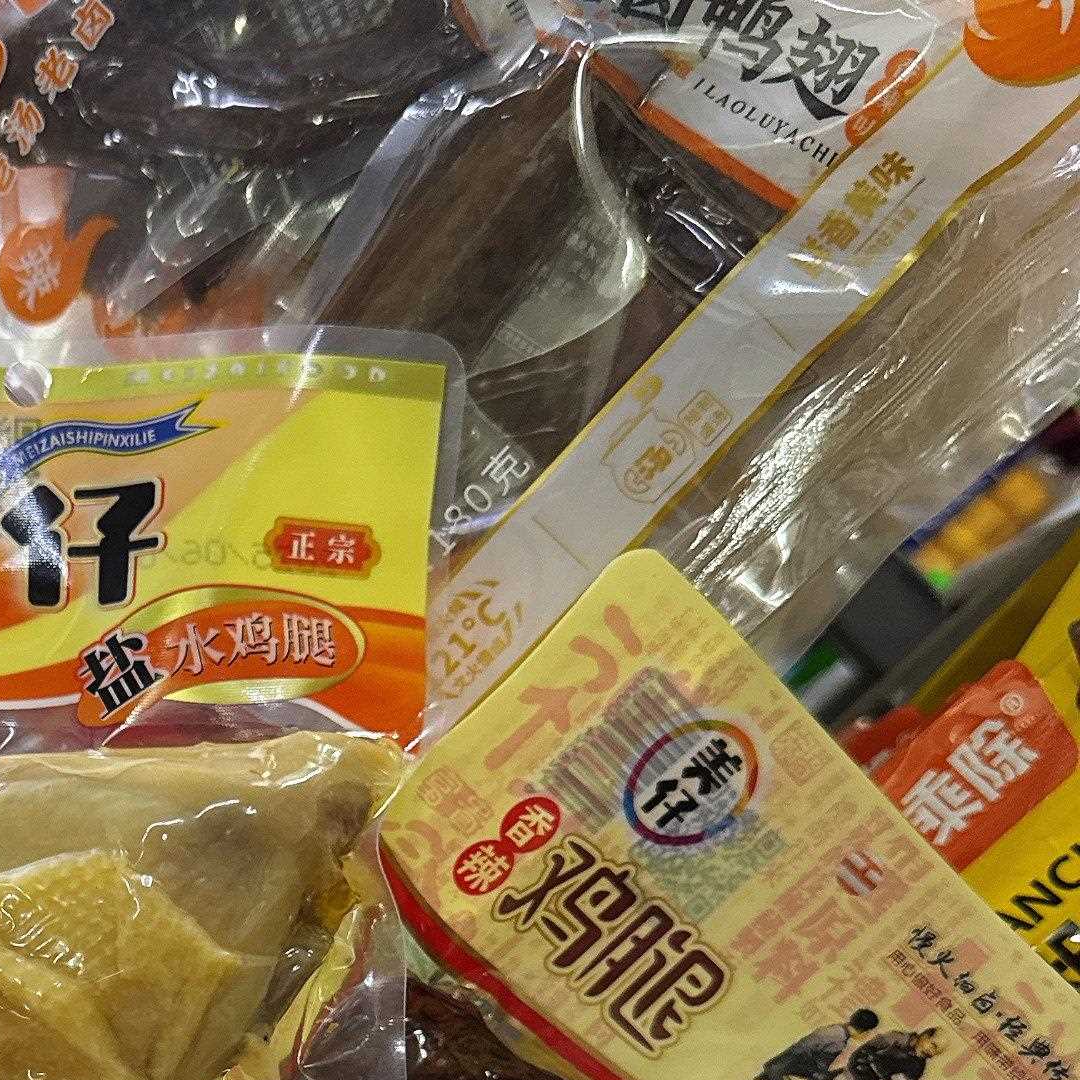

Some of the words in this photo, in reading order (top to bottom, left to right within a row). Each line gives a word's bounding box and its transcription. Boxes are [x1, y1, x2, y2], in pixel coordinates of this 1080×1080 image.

[290, 530, 358, 565] 正宗
[83, 612, 337, 720] 盐水鸡腿
[640, 738, 744, 830] 美仔
[457, 802, 555, 892] 香辣
[493, 836, 727, 1052] 鸡腿
